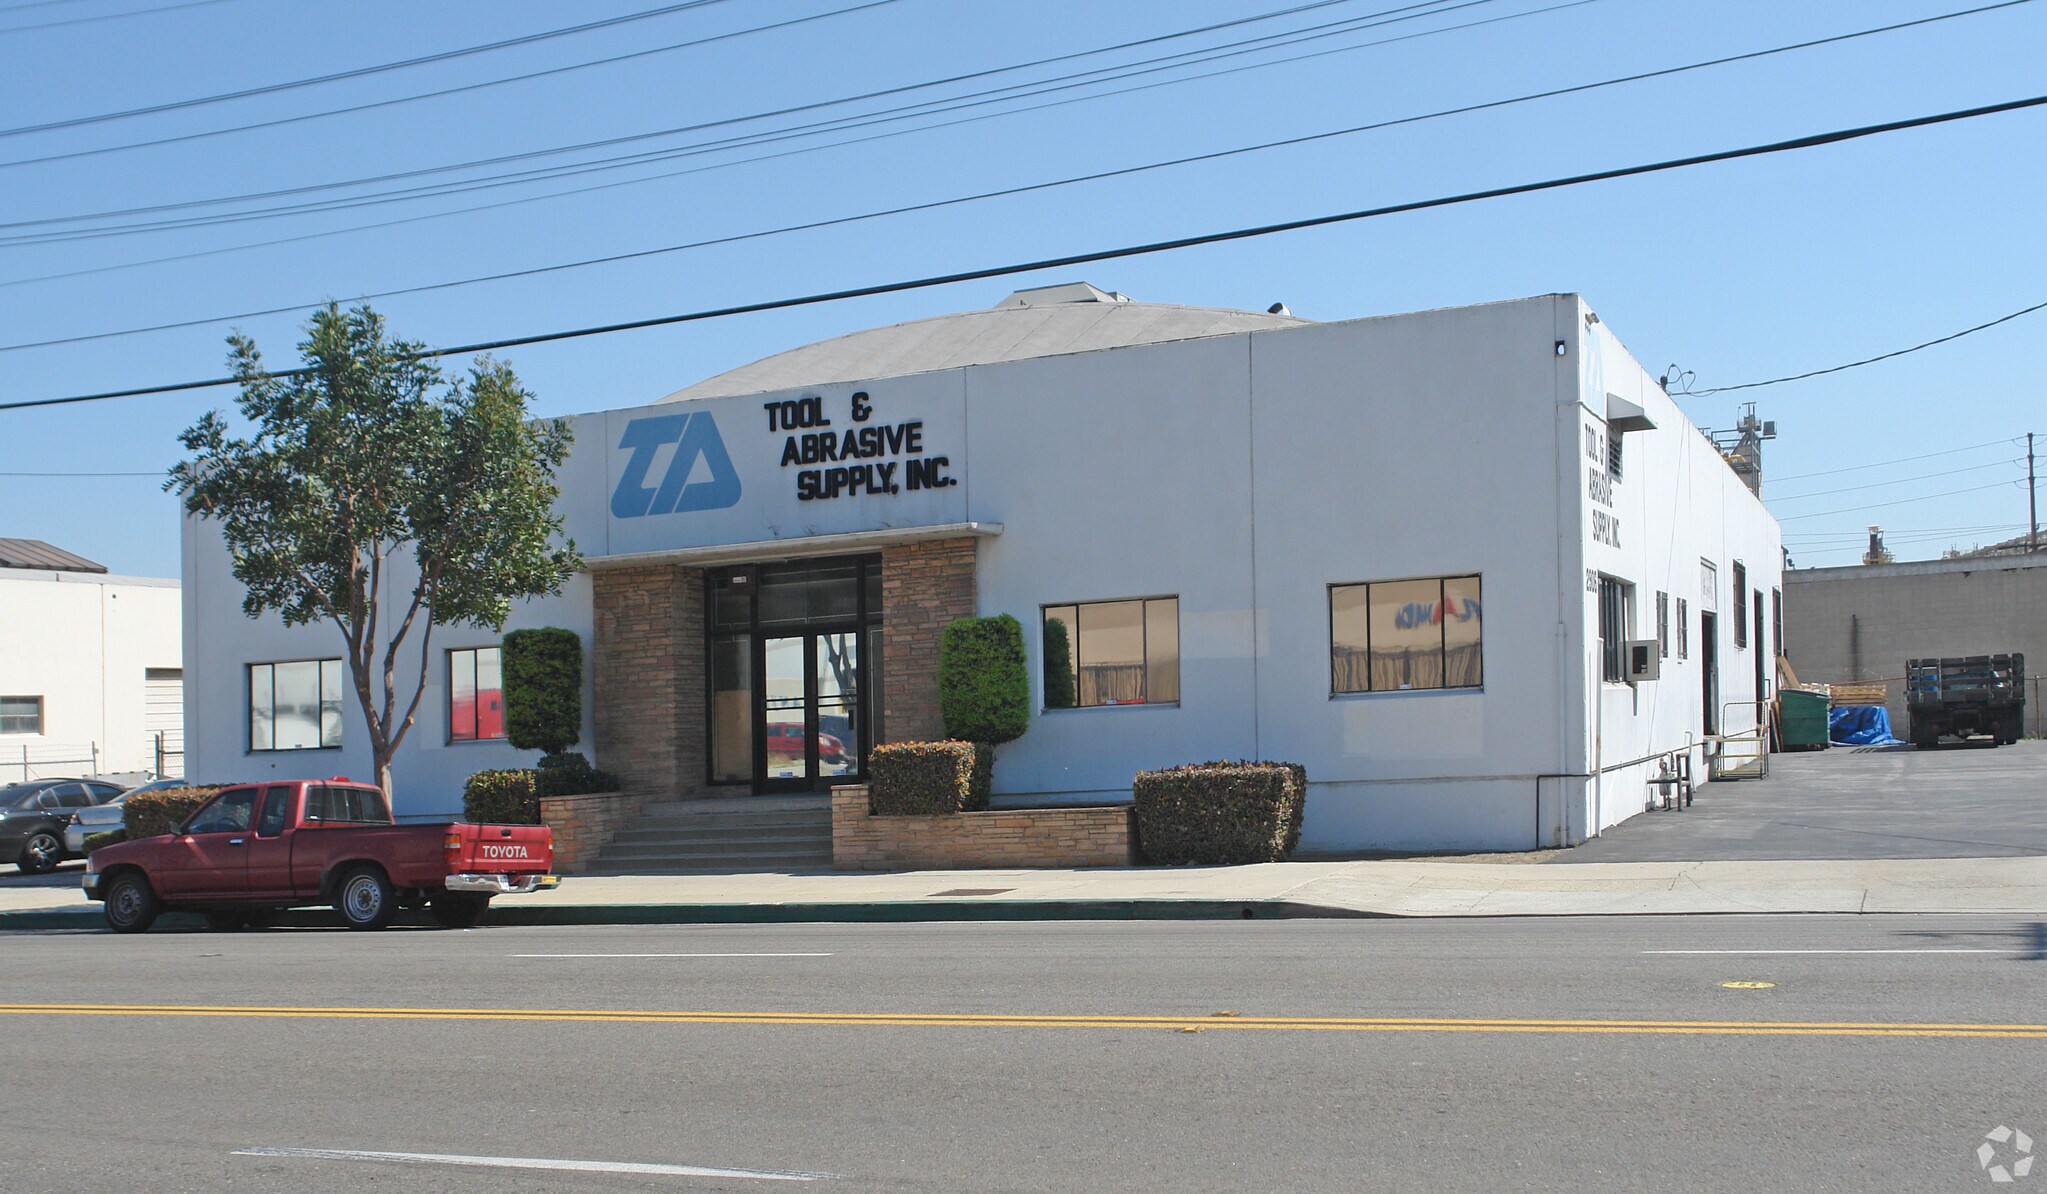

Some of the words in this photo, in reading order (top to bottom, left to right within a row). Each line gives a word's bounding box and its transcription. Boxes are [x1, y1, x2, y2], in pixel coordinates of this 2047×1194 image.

[764, 397, 830, 431] TOOL
[851, 391, 872, 422] &
[780, 421, 923, 467] ABRASIVE
[1585, 422, 1598, 462] TOOL
[797, 461, 898, 500] SUPPLY,
[906, 456, 957, 490] INC.
[1589, 466, 1613, 508] ABRASIVE
[482, 845, 528, 858] TOYOTA
